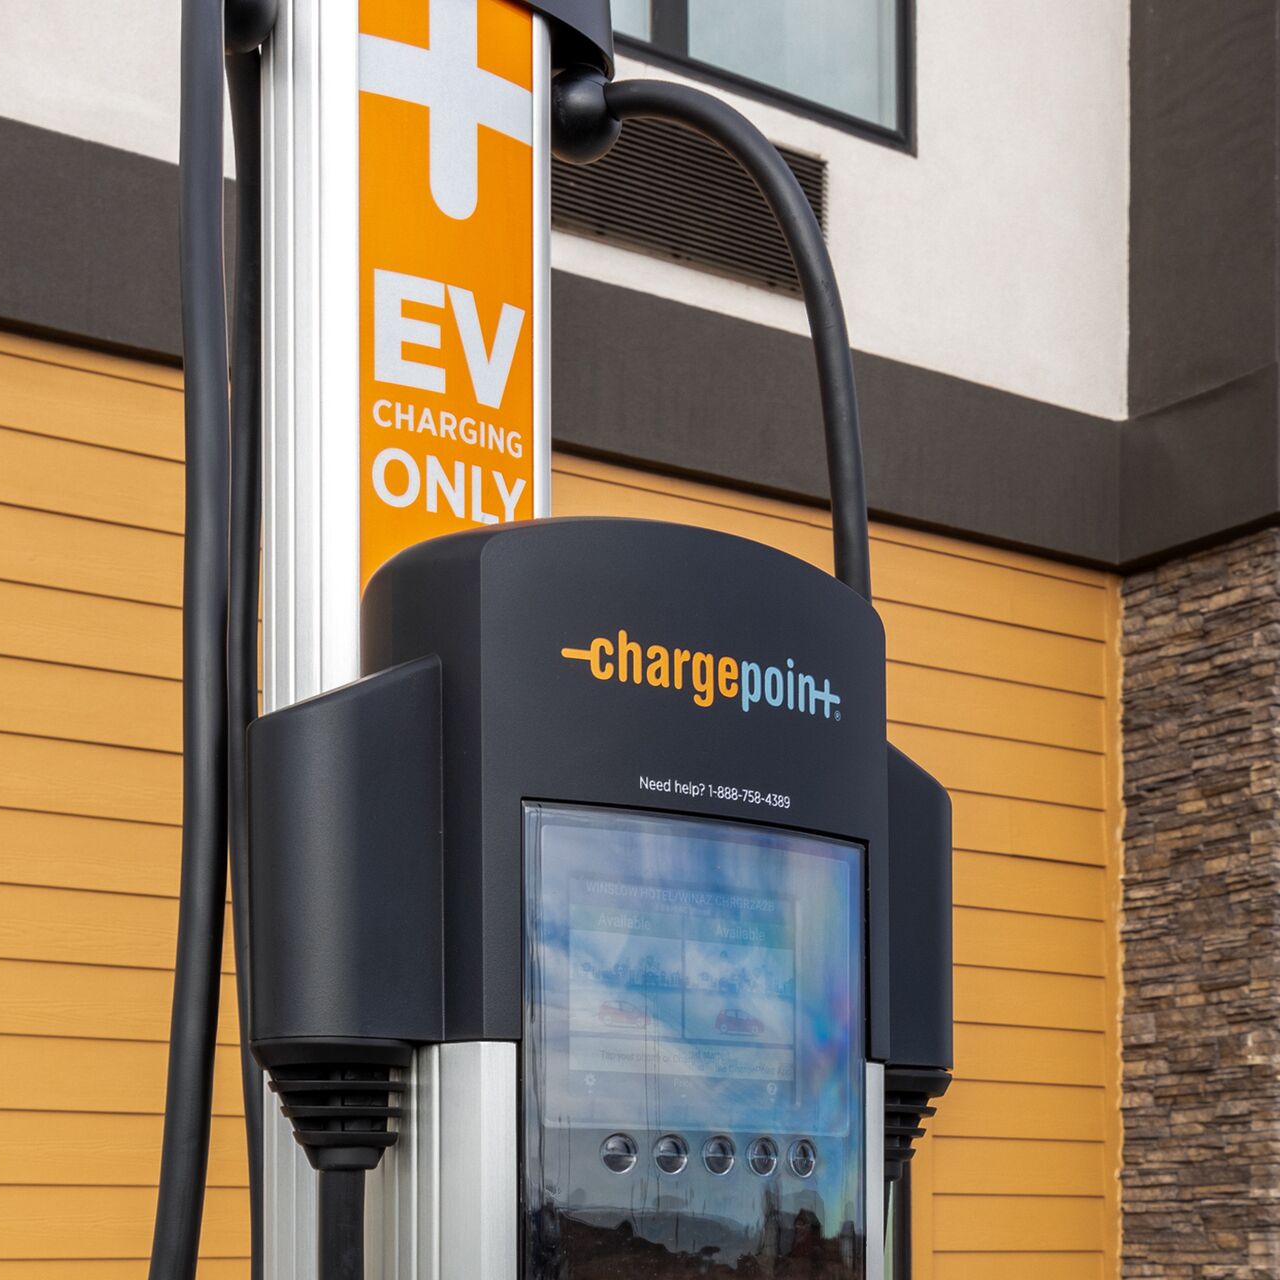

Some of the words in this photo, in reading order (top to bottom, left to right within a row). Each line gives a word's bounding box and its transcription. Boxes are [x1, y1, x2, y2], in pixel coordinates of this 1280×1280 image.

[374, 268, 526, 410] EV
[372, 399, 523, 459] CHARGING
[372, 447, 527, 525] ONLY
[639, 775, 671, 793] Need
[674, 780, 706, 798] help?
[708, 784, 791, 809] 1-888-758-4389
